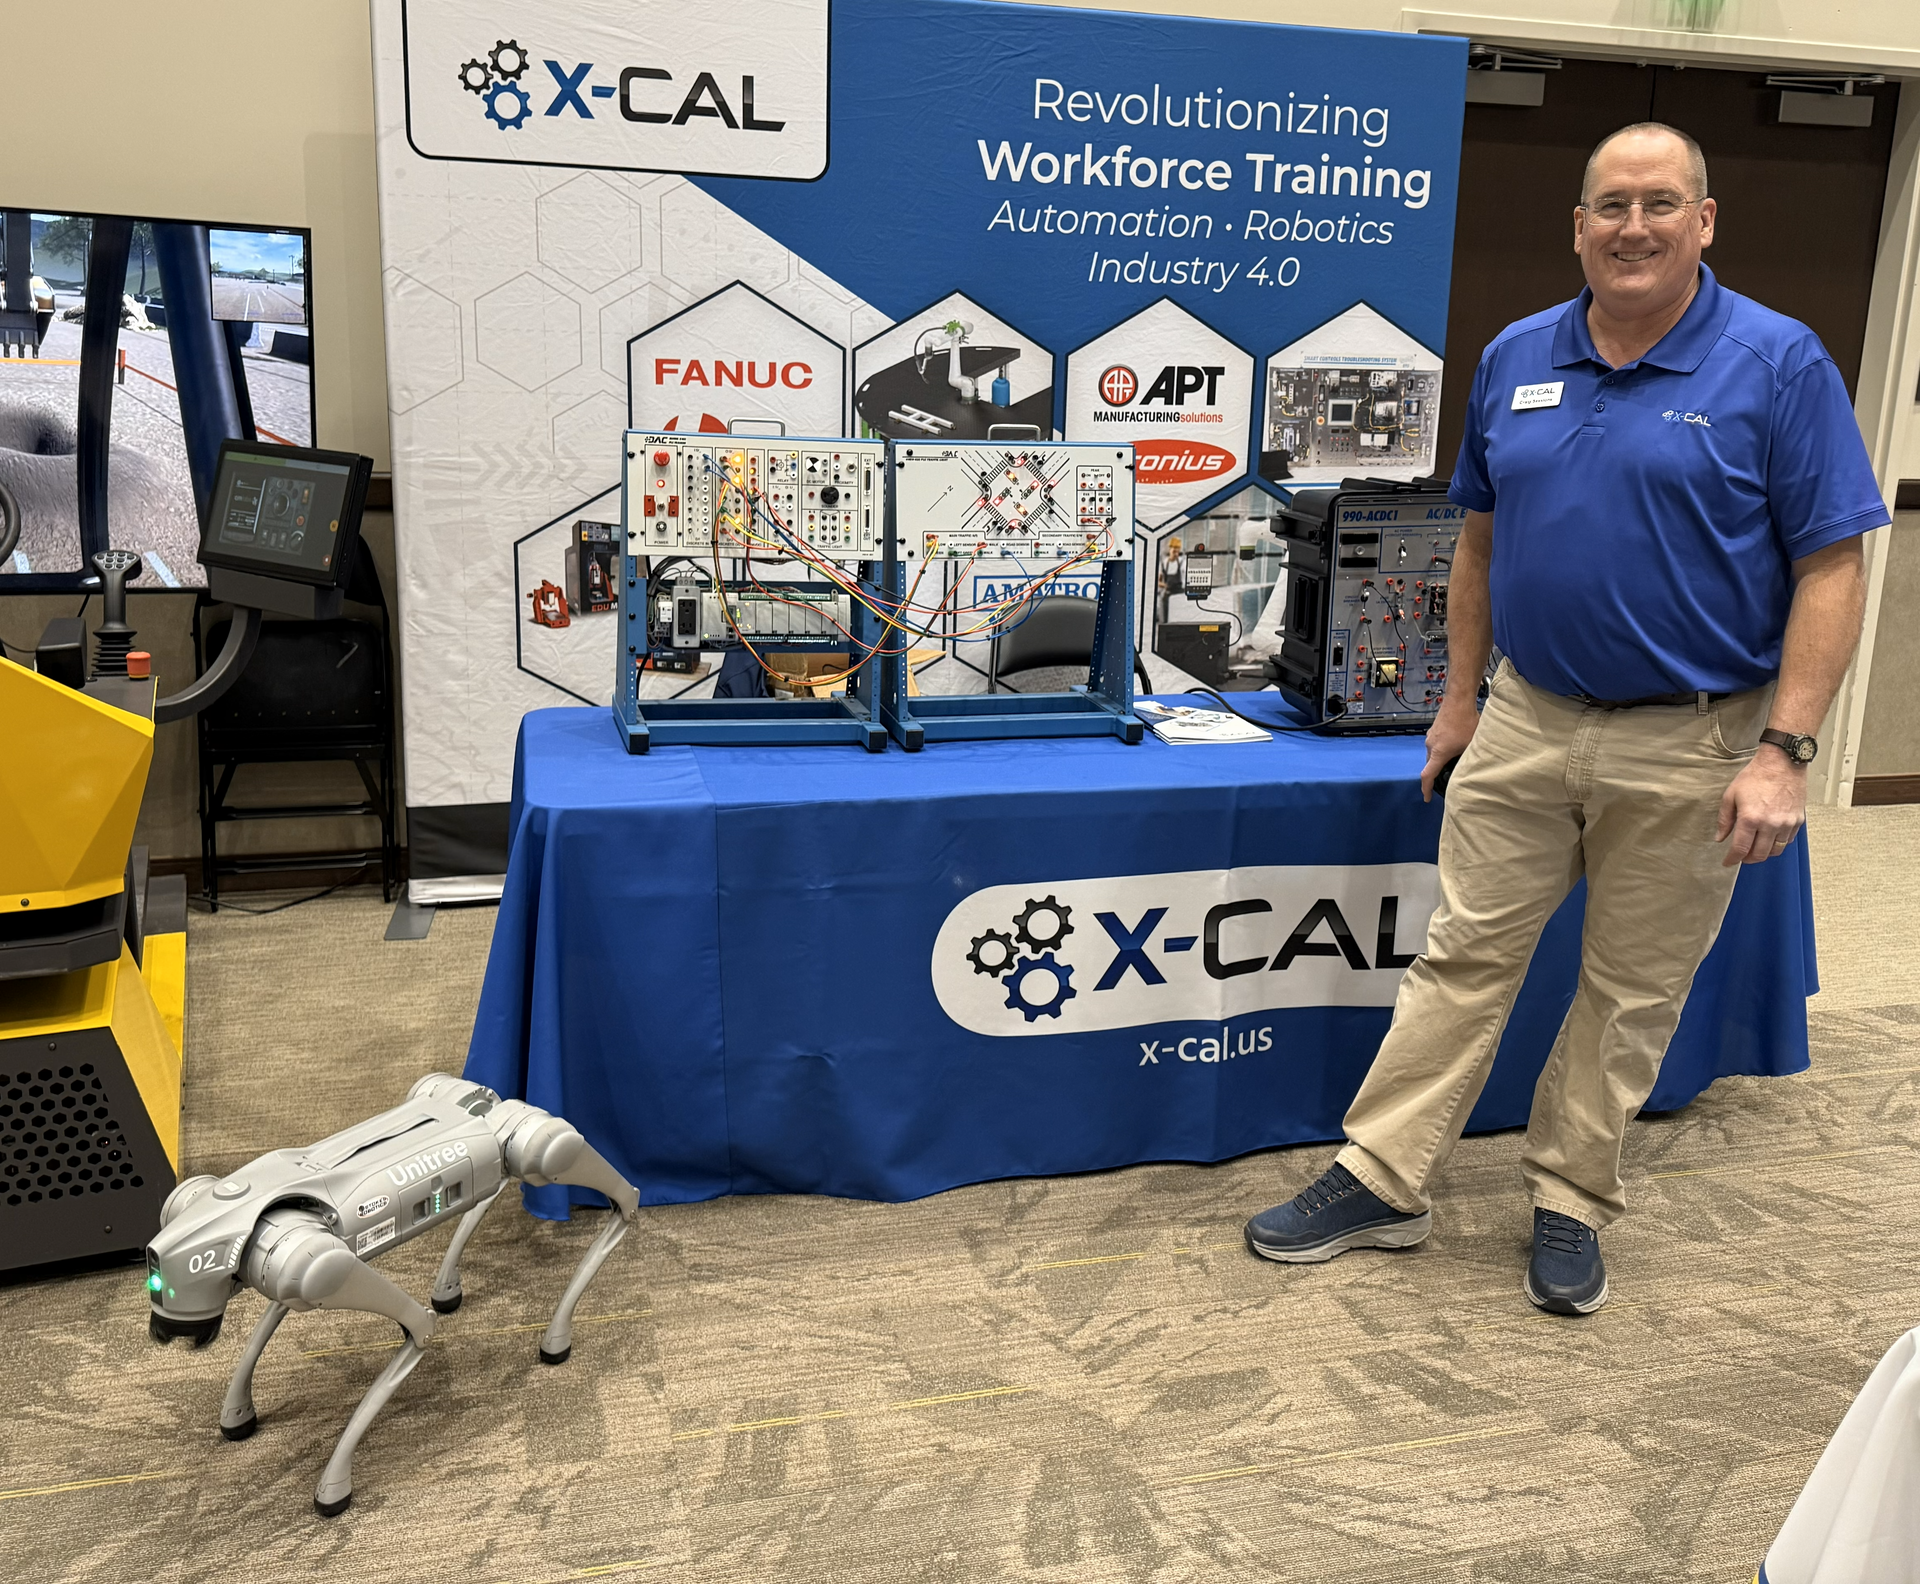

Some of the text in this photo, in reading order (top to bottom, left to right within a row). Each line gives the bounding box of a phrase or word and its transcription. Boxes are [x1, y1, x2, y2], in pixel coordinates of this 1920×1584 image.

[543, 59, 786, 132] X-CAL
[1033, 78, 1390, 147] Revolutionizing
[977, 139, 1432, 209] Workforce Training
[988, 199, 1395, 245] Automation Robotics
[1088, 252, 1301, 293] Industry 4.0
[654, 358, 813, 389] FANUC
[1139, 366, 1225, 406] APT
[1672, 411, 1712, 427] X-CAL
[1135, 450, 1225, 471] onius
[1342, 510, 1398, 522] 990-ACDC1
[1426, 507, 1459, 520] AC/DC
[591, 603, 610, 612] EDU
[1093, 895, 1426, 992] X-CAL
[1138, 1026, 1273, 1067] x-cal.us
[387, 1141, 468, 1189] Unitree
[188, 1249, 217, 1274] 02
